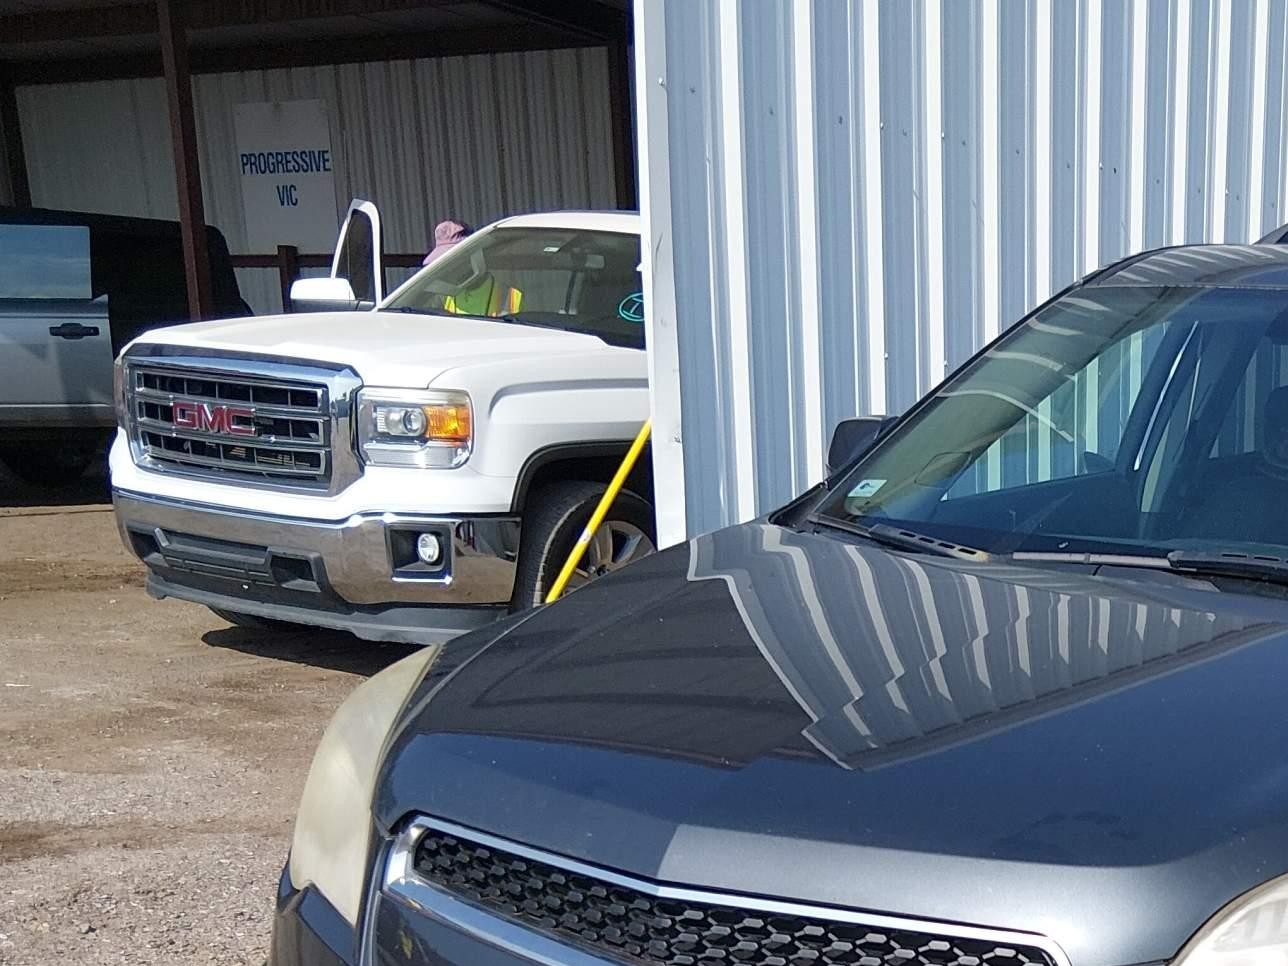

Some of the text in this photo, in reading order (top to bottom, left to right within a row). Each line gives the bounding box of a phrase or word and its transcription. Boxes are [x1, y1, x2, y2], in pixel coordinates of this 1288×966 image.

[240, 150, 331, 175] PROGRESSIVE
[276, 184, 299, 206] VIC
[172, 401, 257, 436] GMC
